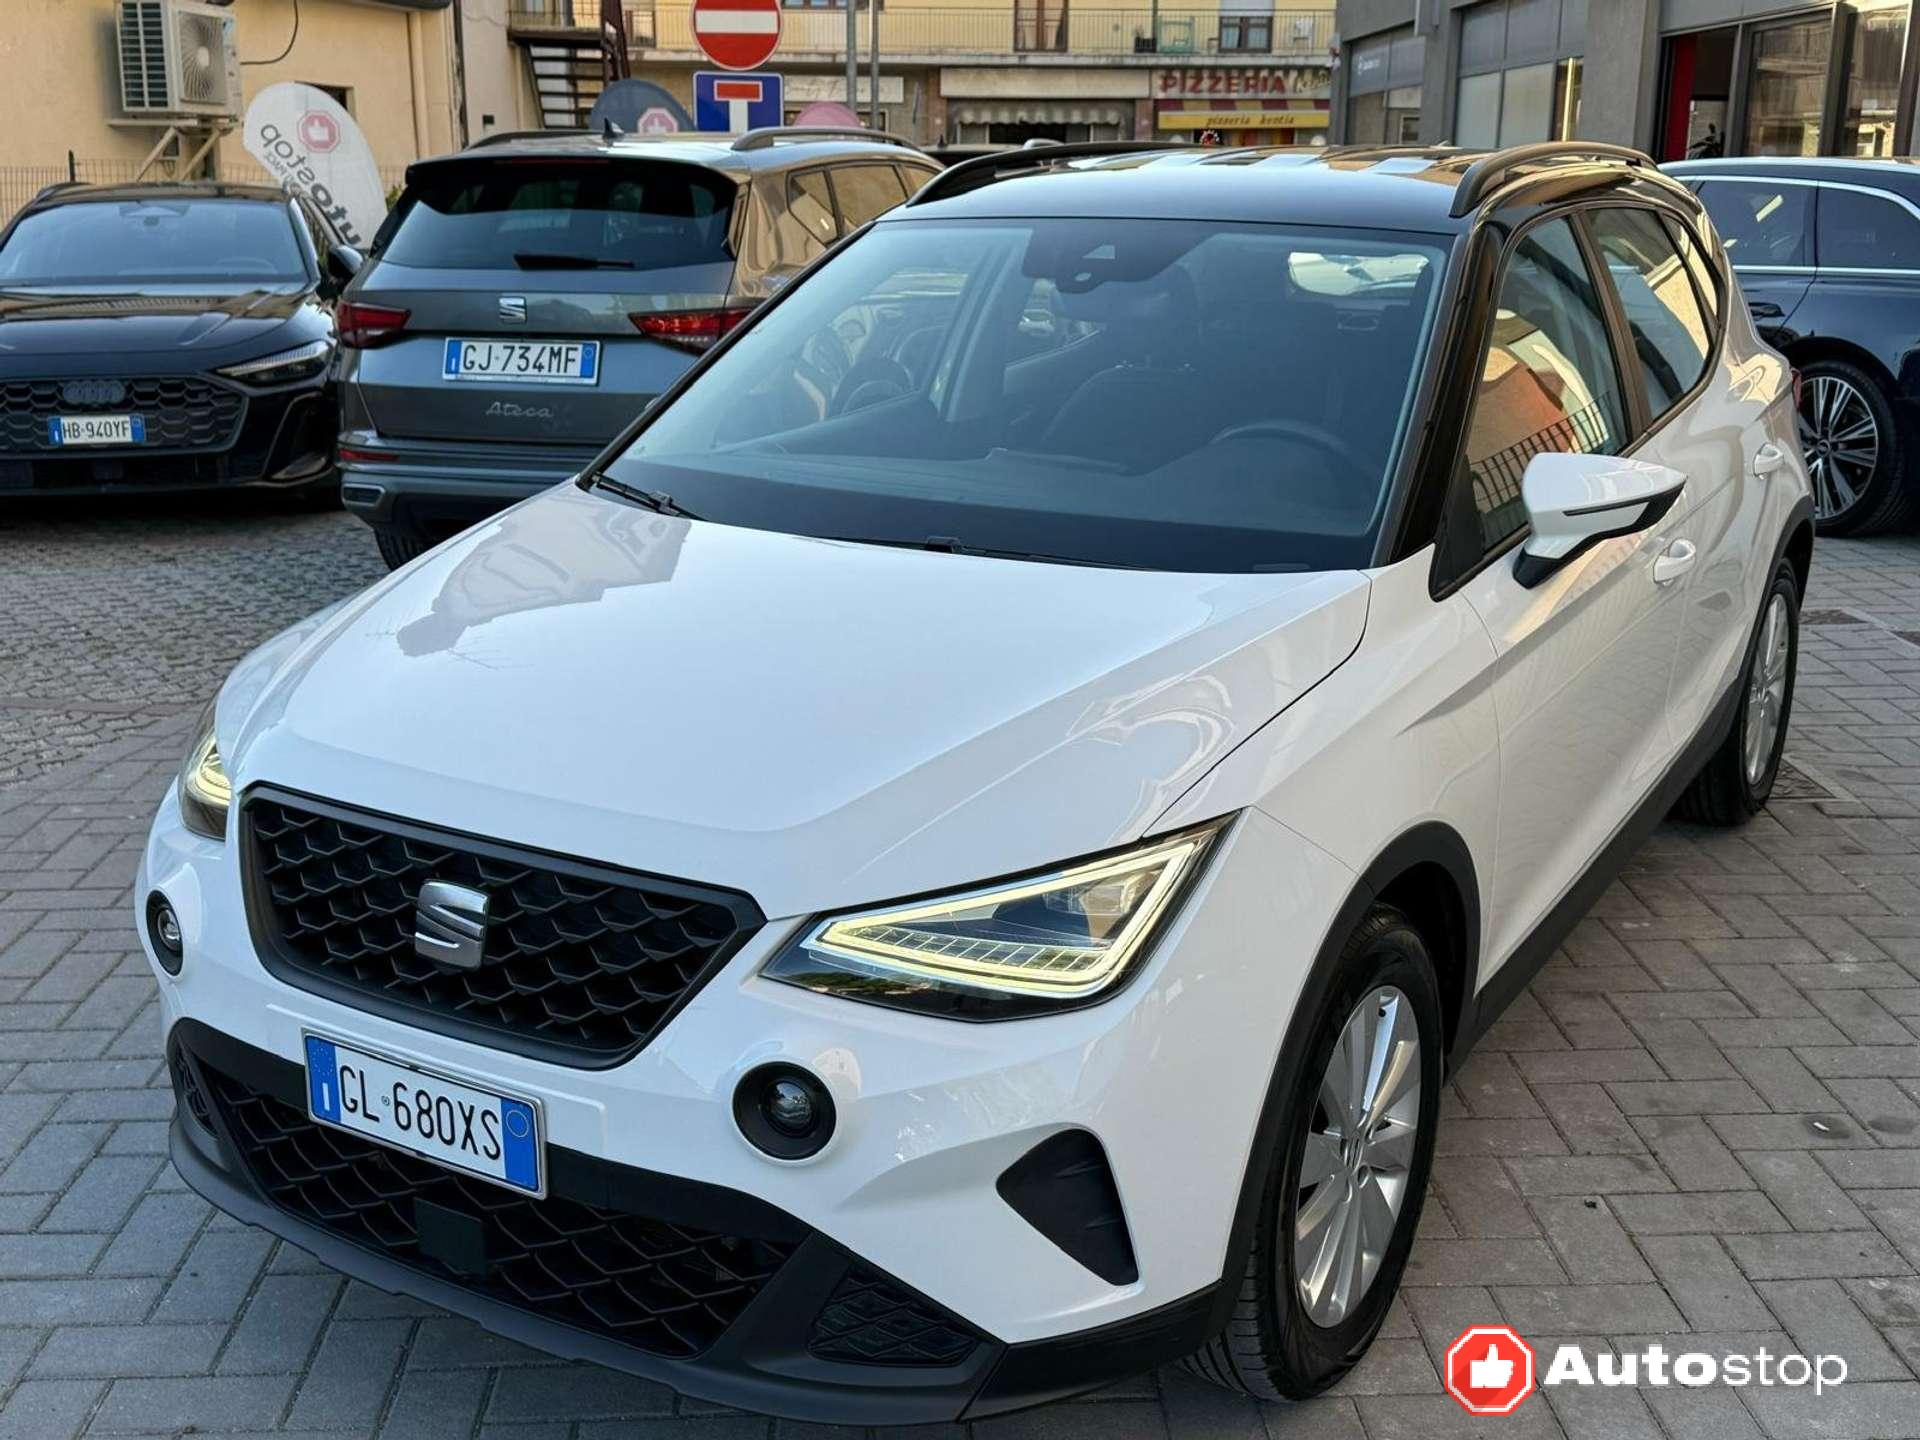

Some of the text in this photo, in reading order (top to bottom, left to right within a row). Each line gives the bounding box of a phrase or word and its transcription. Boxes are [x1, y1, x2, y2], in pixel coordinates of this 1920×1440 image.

[1161, 74, 1287, 94] PIZZERIA
[1205, 114, 1250, 126] pizzeria
[501, 345, 579, 374] 734MF
[485, 401, 554, 418] Ateca
[392, 1082, 502, 1160] 680XS
